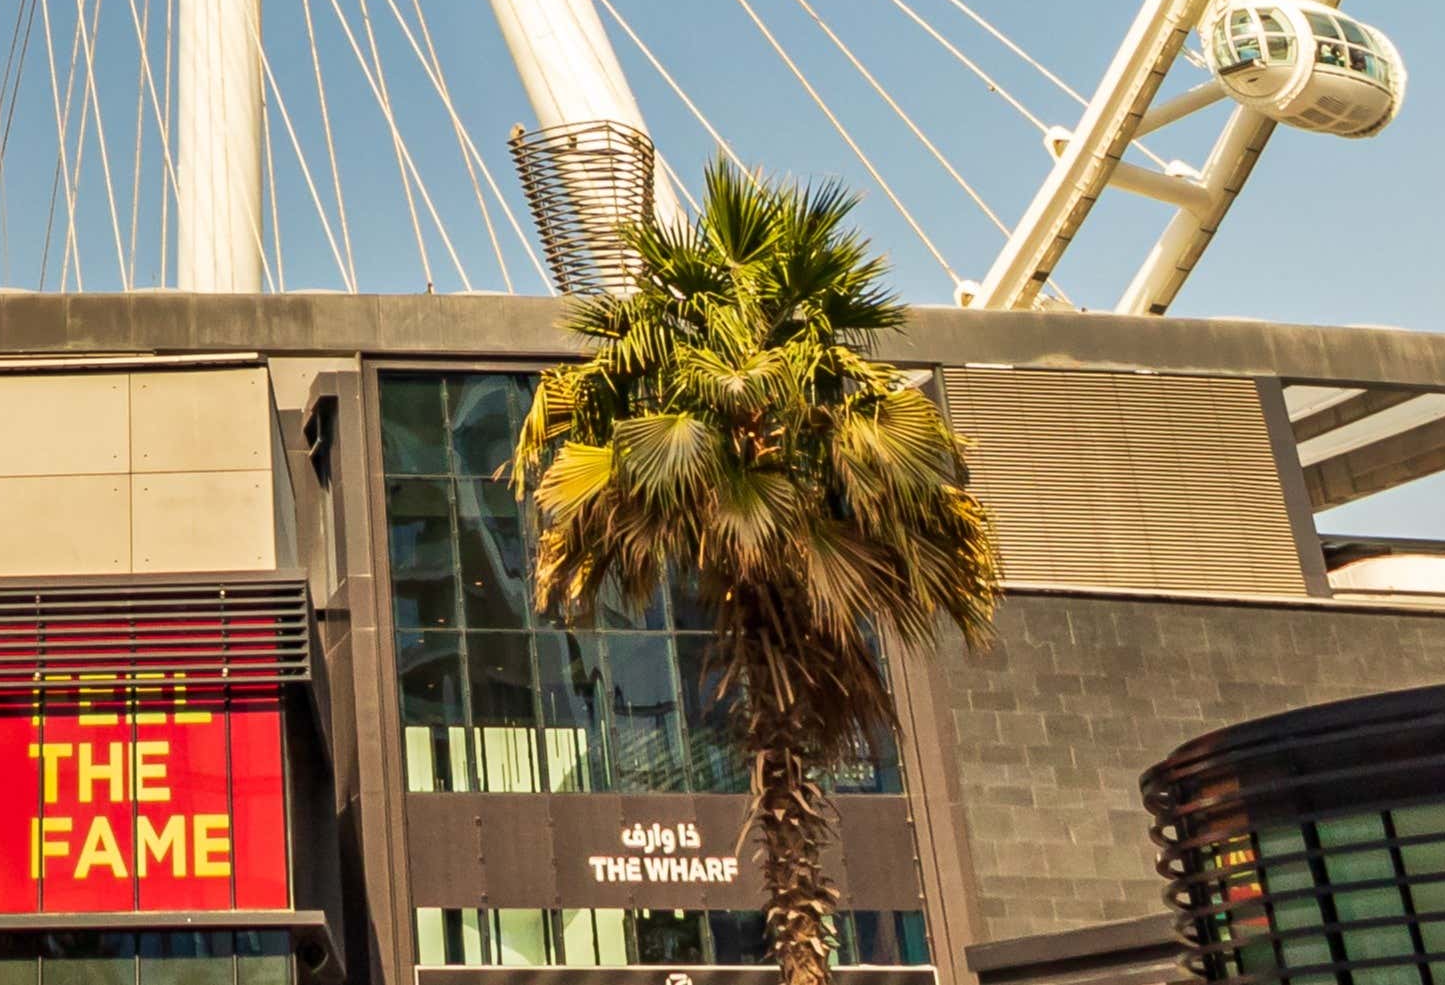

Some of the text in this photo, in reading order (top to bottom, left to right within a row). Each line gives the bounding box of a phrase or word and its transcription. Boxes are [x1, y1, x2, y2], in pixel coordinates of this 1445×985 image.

[28, 741, 171, 803] THE
[30, 814, 232, 879] FAME
[621, 822, 702, 854] ذا وارف
[588, 856, 739, 883] THE WHARF
